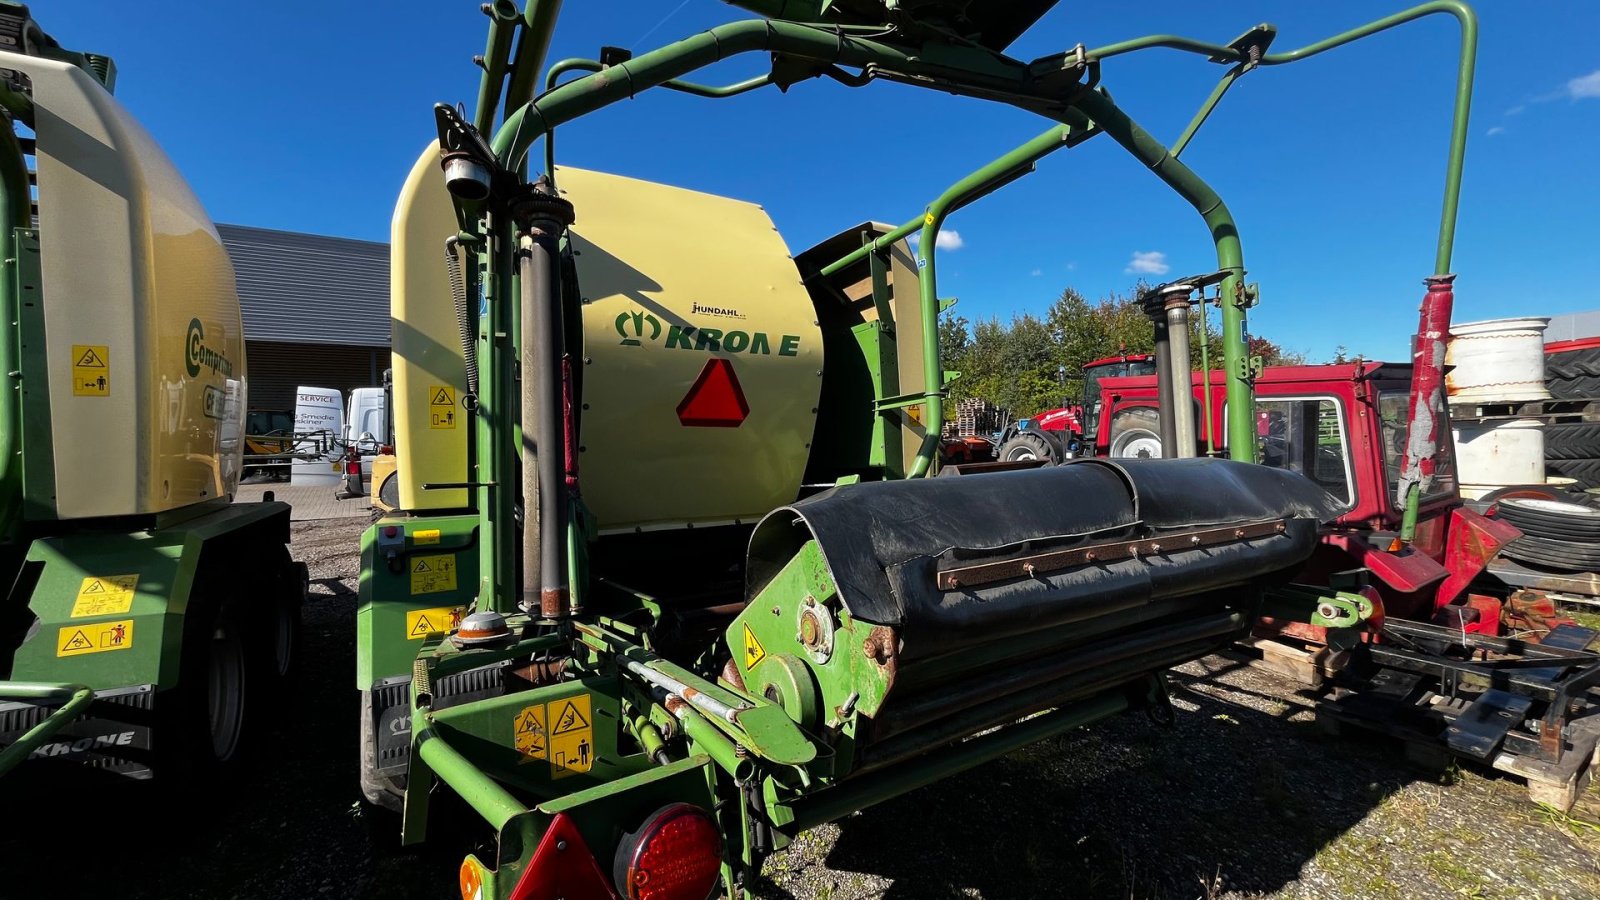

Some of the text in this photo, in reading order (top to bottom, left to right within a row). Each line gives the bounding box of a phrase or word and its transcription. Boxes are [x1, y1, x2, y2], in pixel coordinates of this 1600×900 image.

[300, 395, 335, 403] SERVICE
[301, 413, 335, 421] Smedie
[27, 731, 136, 760] KRONE
